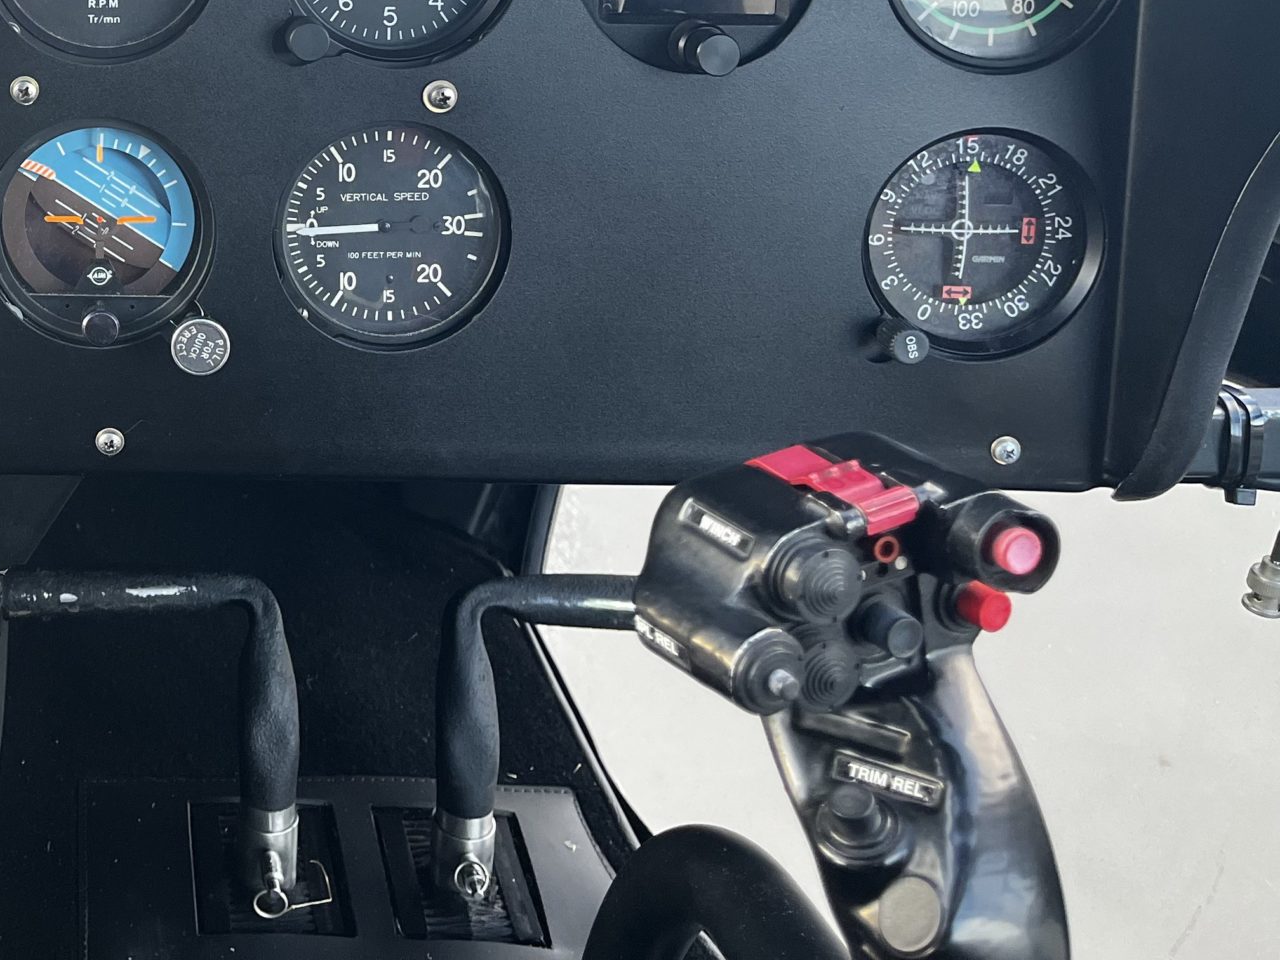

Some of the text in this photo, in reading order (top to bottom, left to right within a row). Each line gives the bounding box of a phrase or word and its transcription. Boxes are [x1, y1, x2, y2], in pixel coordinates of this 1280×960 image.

[383, 7, 397, 26] 5
[952, 0, 979, 17] 100
[88, 15, 120, 24] Tr/mn
[956, 137, 979, 154] 15
[1005, 144, 1028, 165] 18
[383, 150, 395, 162] 15
[907, 151, 932, 171] 12
[339, 163, 355, 182] 10
[417, 169, 442, 188] 20
[1038, 173, 1063, 196] 21
[340, 193, 429, 202] VERTICAL SPEED
[441, 216, 465, 235] 30
[1054, 216, 1072, 240] 24
[972, 255, 1005, 263] GARMIN
[340, 272, 356, 290] 10
[417, 264, 441, 283] 20
[1040, 260, 1062, 287] 27
[383, 290, 394, 303] 15
[1004, 295, 1030, 318] 30
[958, 313, 983, 329] 33
[177, 326, 197, 355] ERECT
[188, 333, 206, 359] QUICK
[200, 341, 214, 359] FOR
[905, 336, 918, 359] OBS
[206, 340, 224, 366] PULL
[848, 763, 924, 798] TRIM REL
